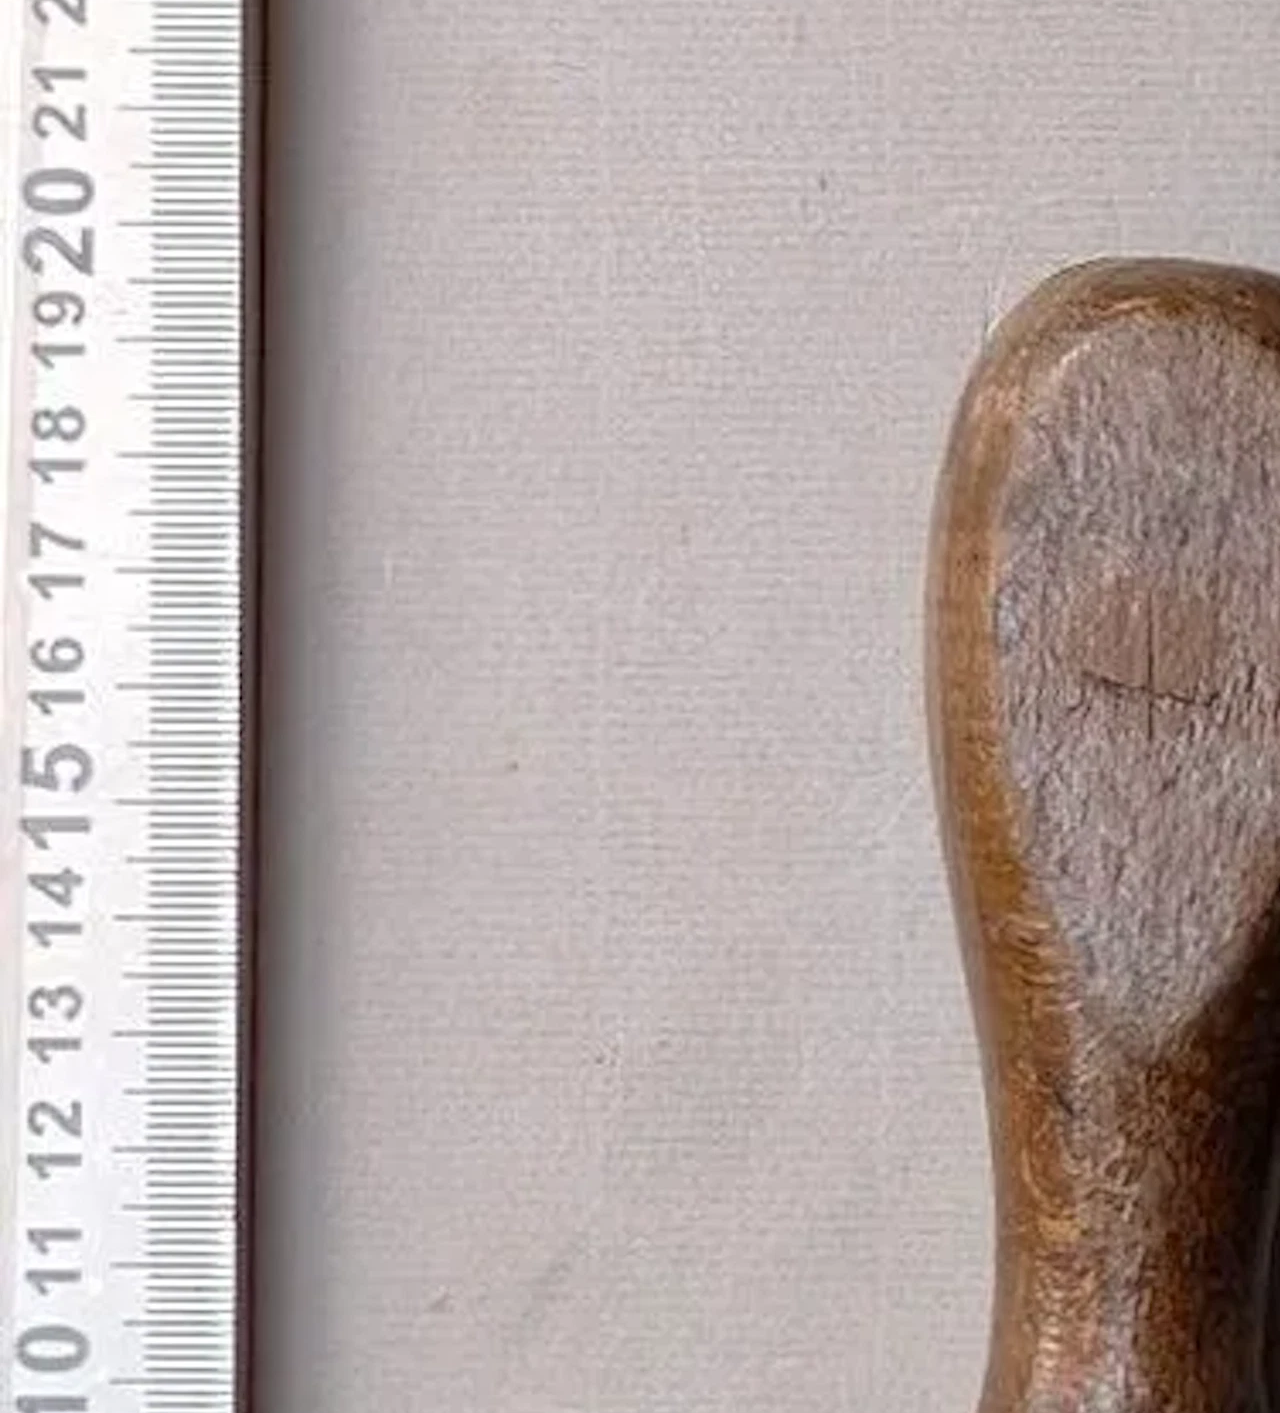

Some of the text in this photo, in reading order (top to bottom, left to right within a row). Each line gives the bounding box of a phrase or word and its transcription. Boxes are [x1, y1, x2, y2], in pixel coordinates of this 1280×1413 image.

[30, 67, 88, 141] 21
[20, 168, 95, 276] 20
[29, 292, 86, 369] 19
[26, 406, 87, 484] 18
[28, 521, 87, 600] 17
[26, 637, 85, 716] 16
[18, 743, 93, 850] 15
[27, 867, 84, 948] 14
[27, 985, 84, 1064] 13
[26, 1100, 83, 1180] 12
[25, 1228, 83, 1296] 11
